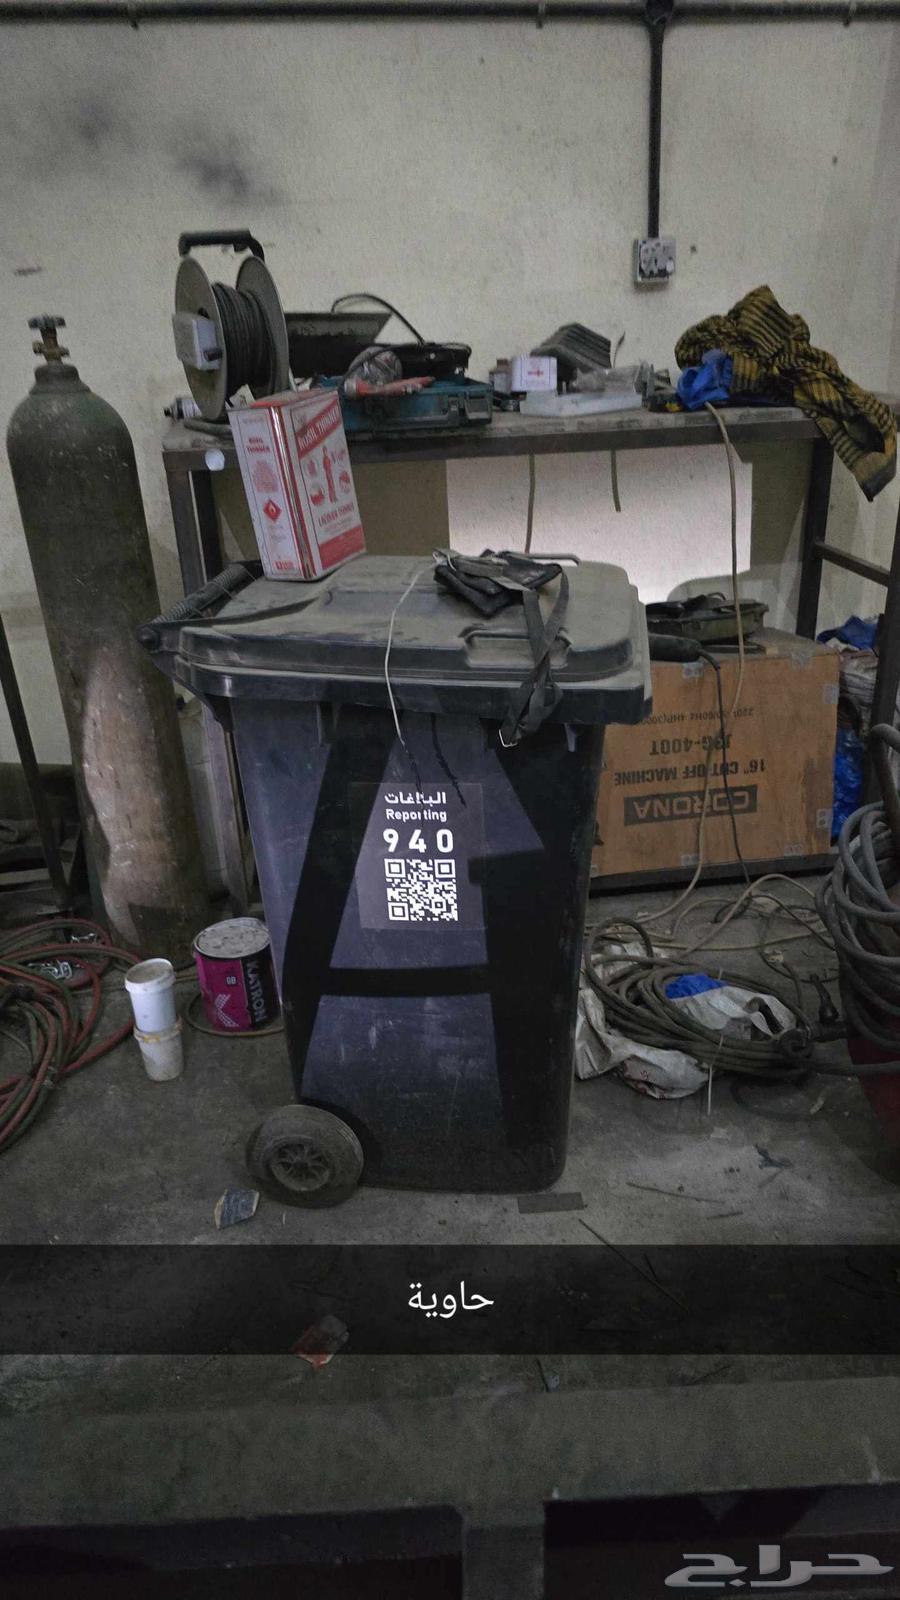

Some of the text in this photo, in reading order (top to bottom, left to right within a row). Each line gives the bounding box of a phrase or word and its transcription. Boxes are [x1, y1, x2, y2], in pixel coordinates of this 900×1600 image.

[614, 767, 678, 786] MACHINE
[632, 790, 750, 820] CORONA
[385, 808, 448, 823] Reporting
